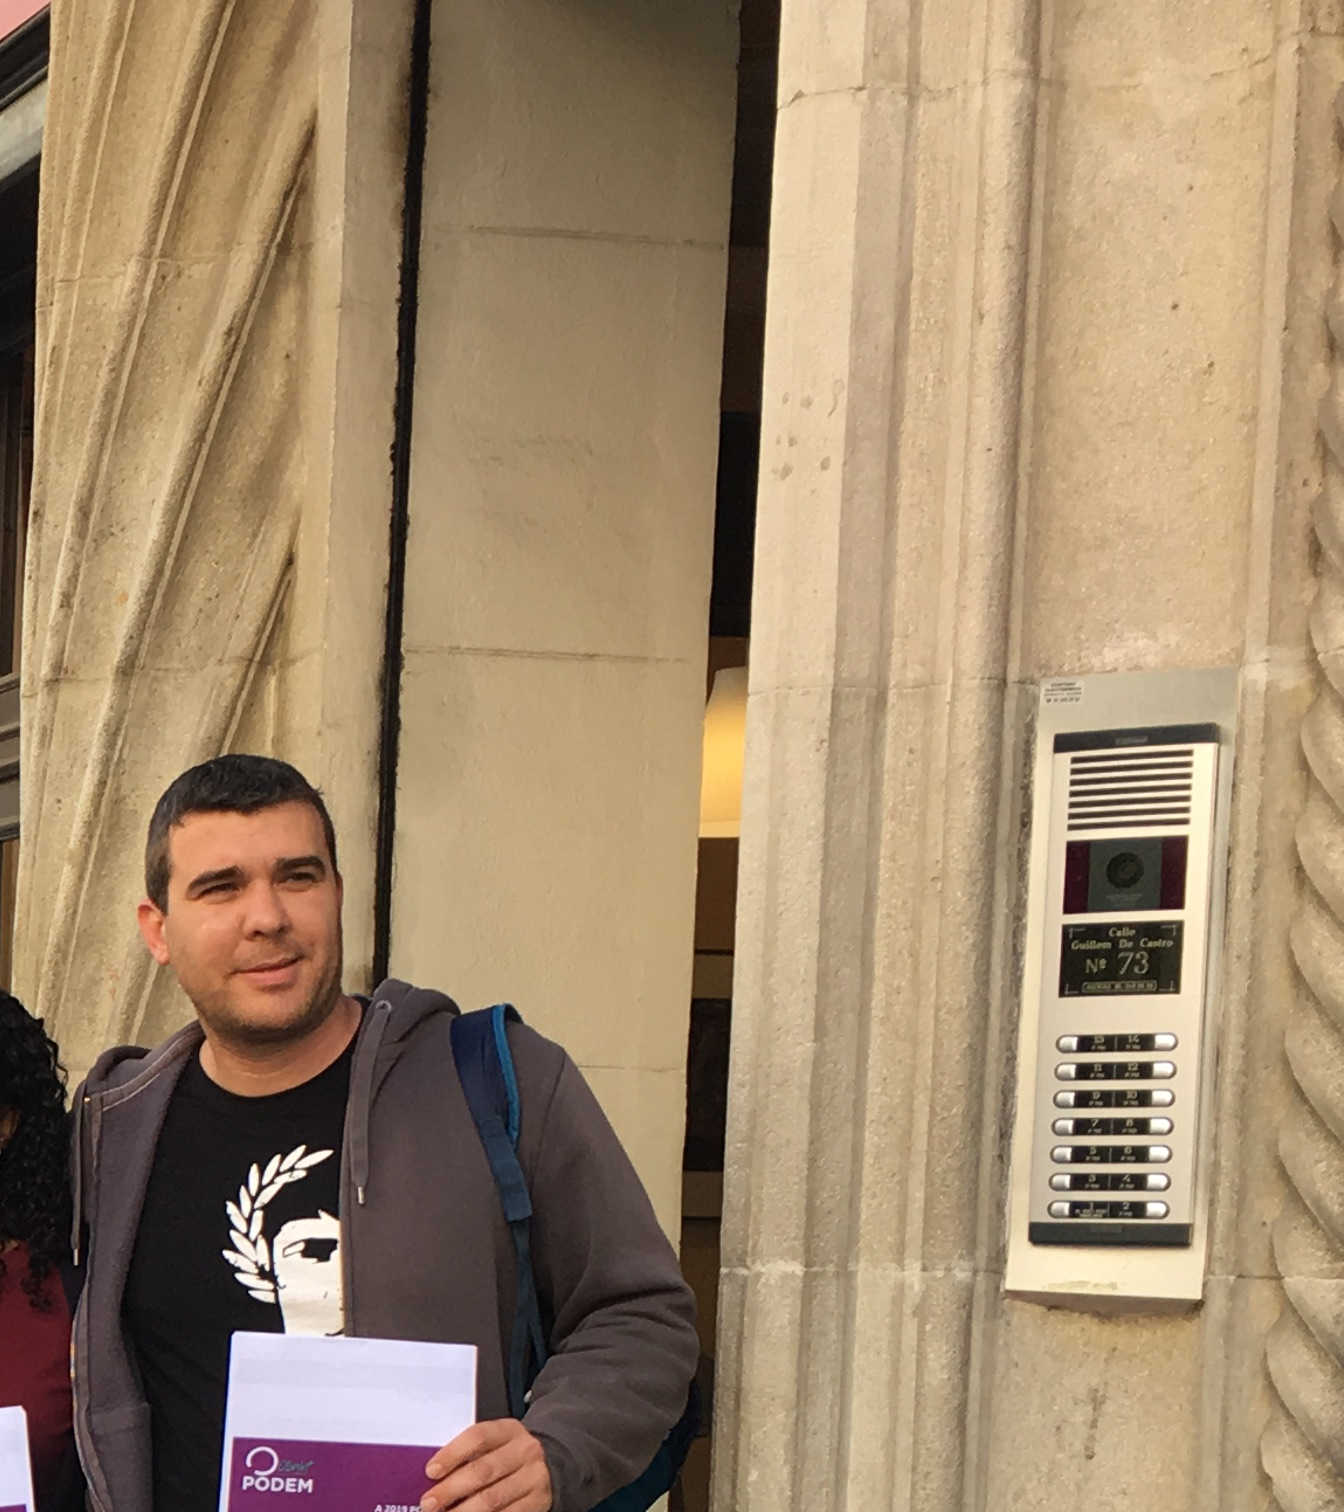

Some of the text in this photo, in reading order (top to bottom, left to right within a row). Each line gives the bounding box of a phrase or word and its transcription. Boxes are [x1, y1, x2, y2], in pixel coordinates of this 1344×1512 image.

[1108, 927, 1136, 937] Calle
[1118, 951, 1149, 974] 73
[242, 1475, 314, 1494] PODEM
[374, 1504, 382, 1512] A
